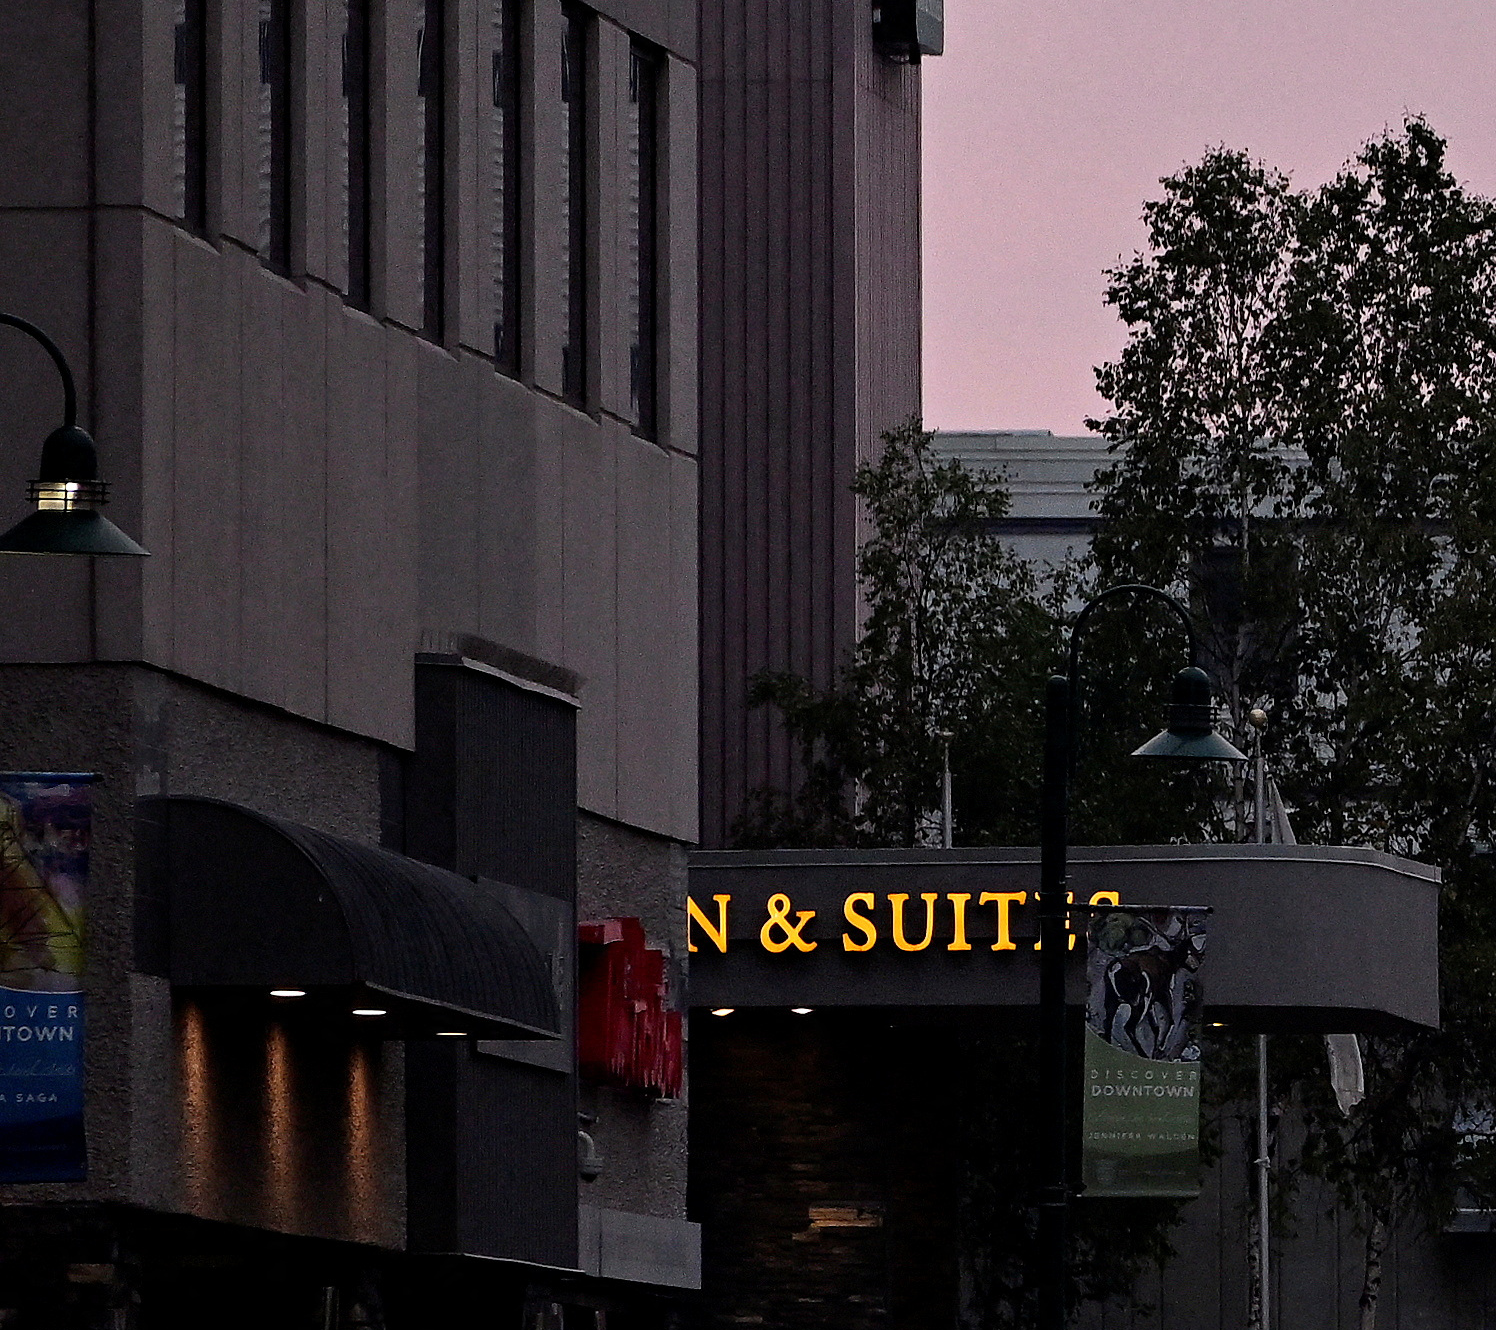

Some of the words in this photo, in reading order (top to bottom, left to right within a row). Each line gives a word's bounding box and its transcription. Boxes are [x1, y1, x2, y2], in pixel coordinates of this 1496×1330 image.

[760, 892, 817, 953] &
[0, 1026, 73, 1041] TOWN
[1090, 1070, 1197, 1081] DISCOVER
[1091, 1085, 1195, 1097] DOWNTOWN
[16, 1093, 58, 1103] SAGA
